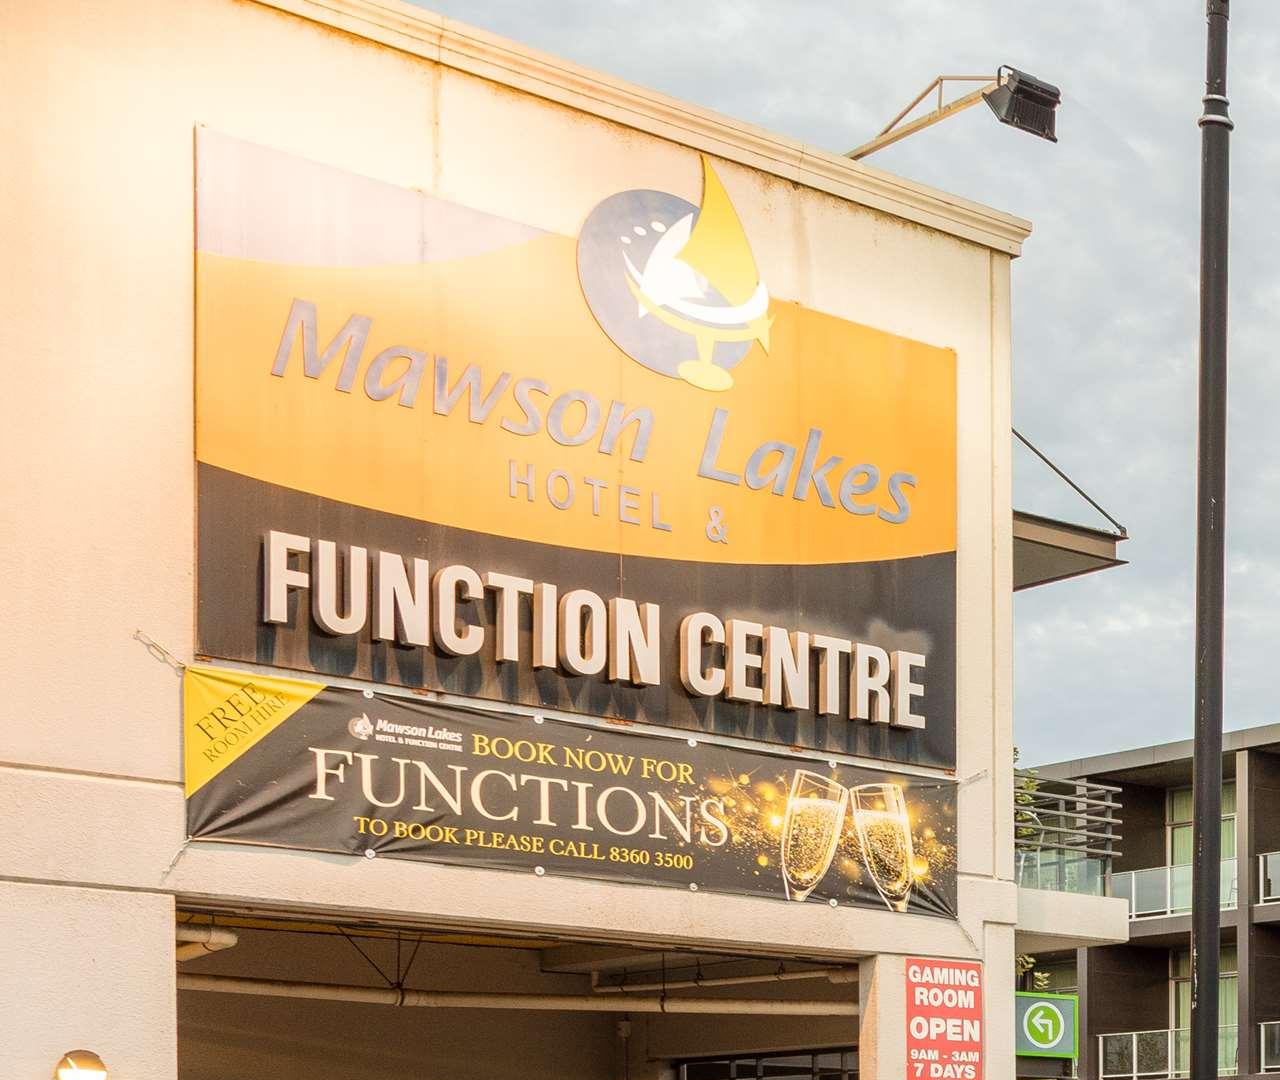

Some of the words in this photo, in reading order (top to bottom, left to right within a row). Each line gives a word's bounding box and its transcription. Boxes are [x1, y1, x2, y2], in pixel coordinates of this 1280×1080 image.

[271, 298, 656, 464] Mawson
[697, 407, 918, 526] Lakes
[508, 458, 674, 533] HOTEL
[705, 506, 728, 545] &
[262, 529, 661, 688] FUNCTION
[680, 610, 927, 731] CENTRE
[194, 682, 268, 741] FREE
[201, 719, 251, 764] ROOM
[248, 691, 291, 734] HIRE
[376, 719, 427, 737] Mawson
[428, 726, 463, 742] Lakes
[472, 733, 557, 767] BOOK
[564, 745, 634, 777] NOW
[641, 757, 696, 785] FOR
[308, 746, 730, 847] FUNCTIONS
[353, 816, 387, 837] TO
[394, 822, 459, 845] BOOK
[465, 831, 544, 854] PLEASE
[550, 839, 605, 861] CALL
[610, 847, 649, 866] 8360
[654, 851, 693, 870] 3500
[908, 965, 980, 987] GAMING
[914, 987, 975, 1008] ROOM
[909, 1016, 980, 1042] OPEN
[910, 1049, 939, 1061] 9AM
[951, 1051, 979, 1062] 3AM
[913, 1063, 924, 1078] 7
[930, 1064, 976, 1080] DAYS
